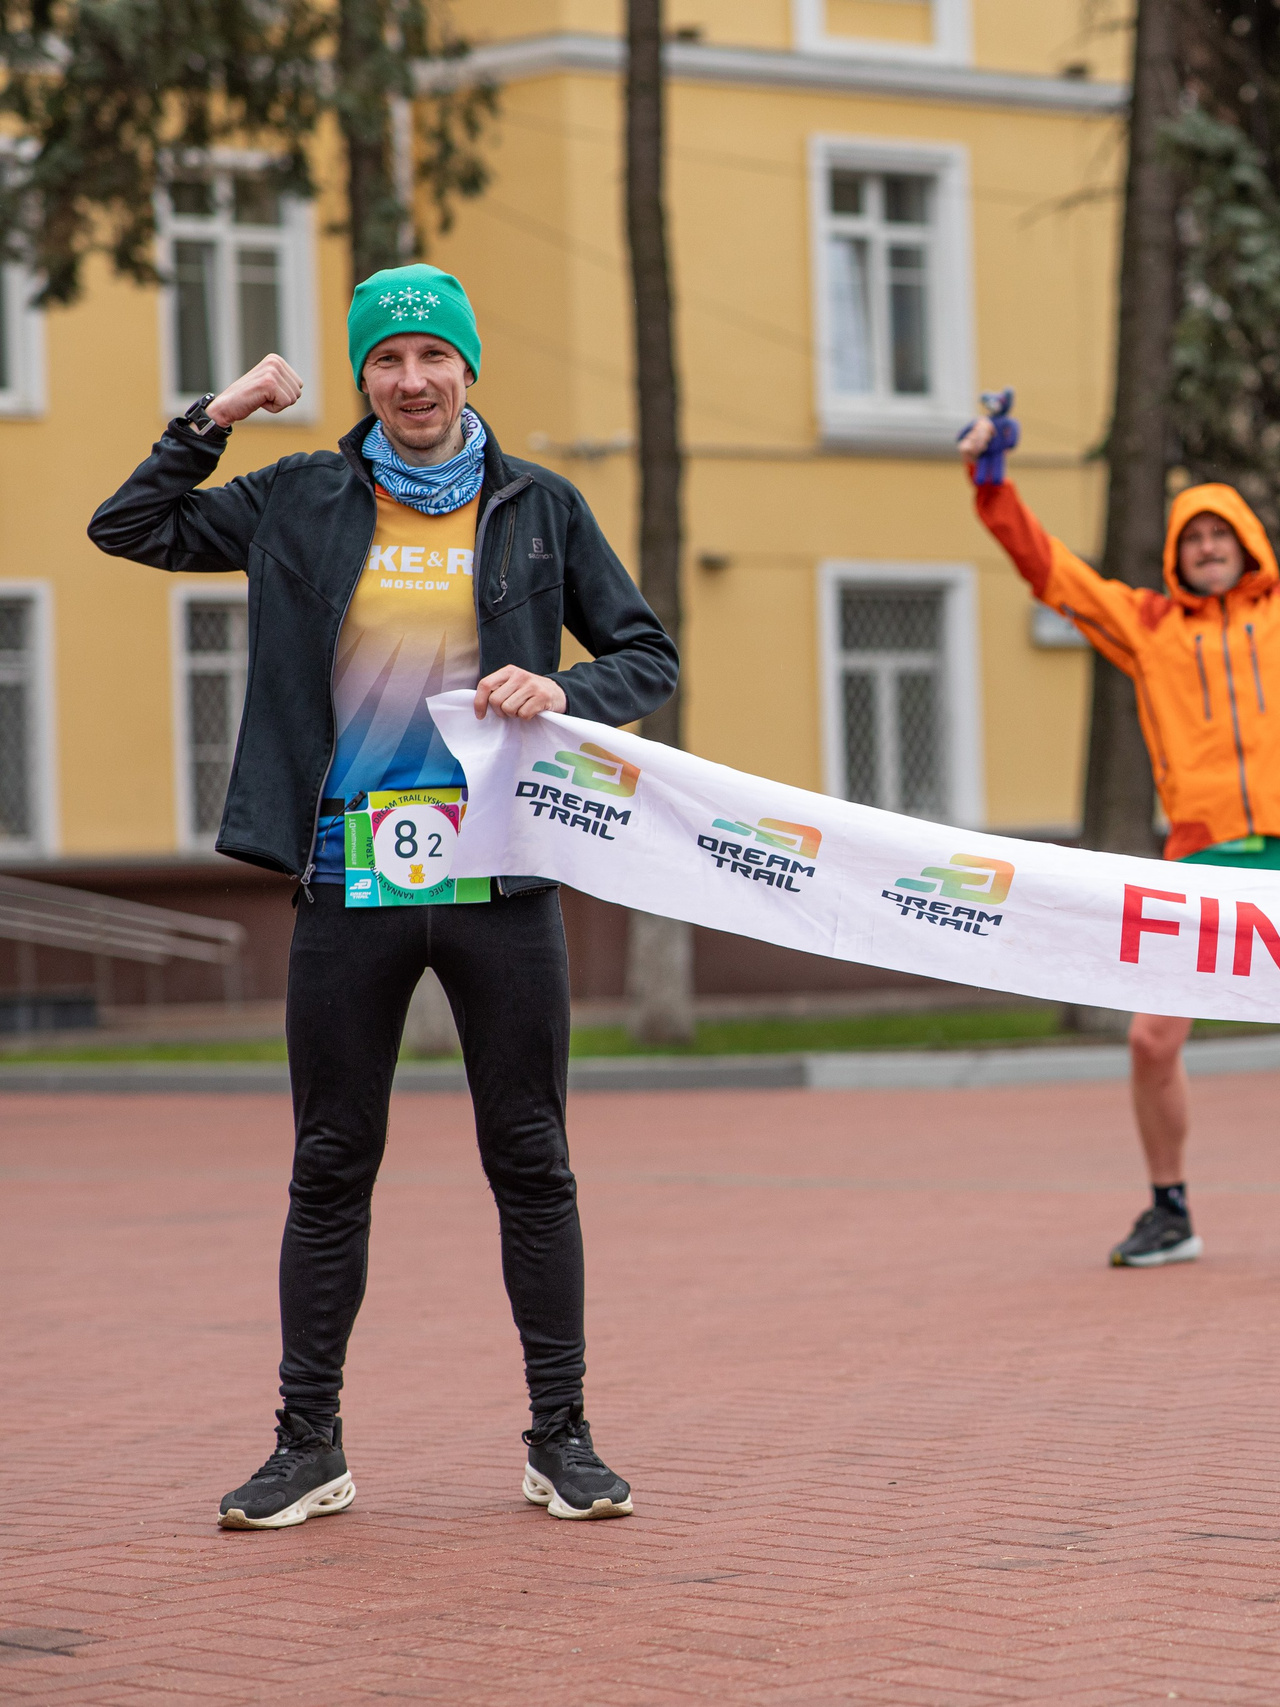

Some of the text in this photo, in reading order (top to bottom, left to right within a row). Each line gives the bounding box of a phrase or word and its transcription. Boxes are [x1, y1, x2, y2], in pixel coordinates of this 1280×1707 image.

[364, 545, 474, 576] KE&R
[380, 578, 450, 591] MOSCOW
[373, 794, 455, 824] DREAM TRAIL LYSKOVO
[515, 781, 632, 825] DREAM
[529, 801, 615, 840] TRAIL
[366, 836, 374, 859] TRAIL
[394, 820, 443, 859] 8 2
[697, 834, 816, 878] DREAM
[382, 880, 414, 900] KANNAS
[711, 854, 801, 893] TRAIL
[881, 889, 1003, 926] DREAM
[896, 903, 989, 936] TRAIL
